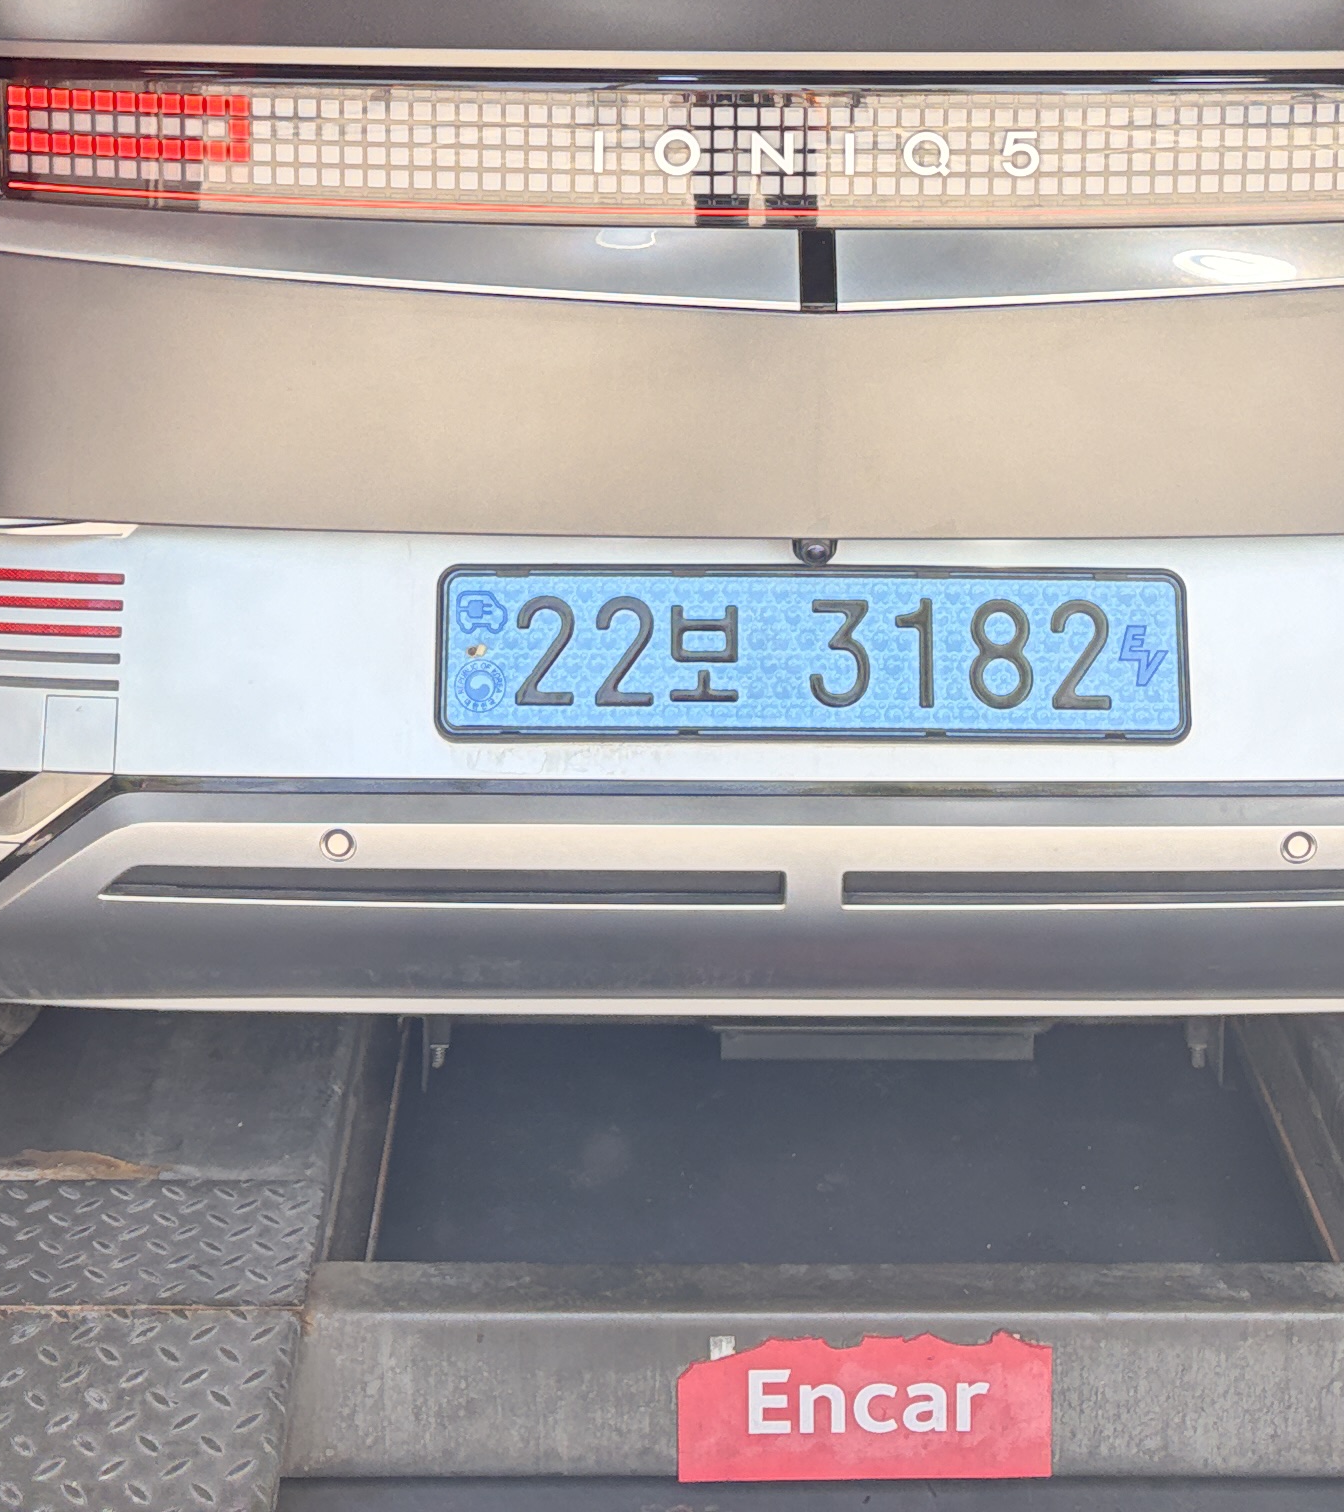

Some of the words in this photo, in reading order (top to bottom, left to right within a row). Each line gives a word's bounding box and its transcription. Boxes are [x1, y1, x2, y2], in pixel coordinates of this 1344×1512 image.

[514, 595, 740, 708] 22보
[808, 597, 1113, 711] 3182
[1119, 624, 1170, 687] EV
[747, 1369, 991, 1435] Encar
